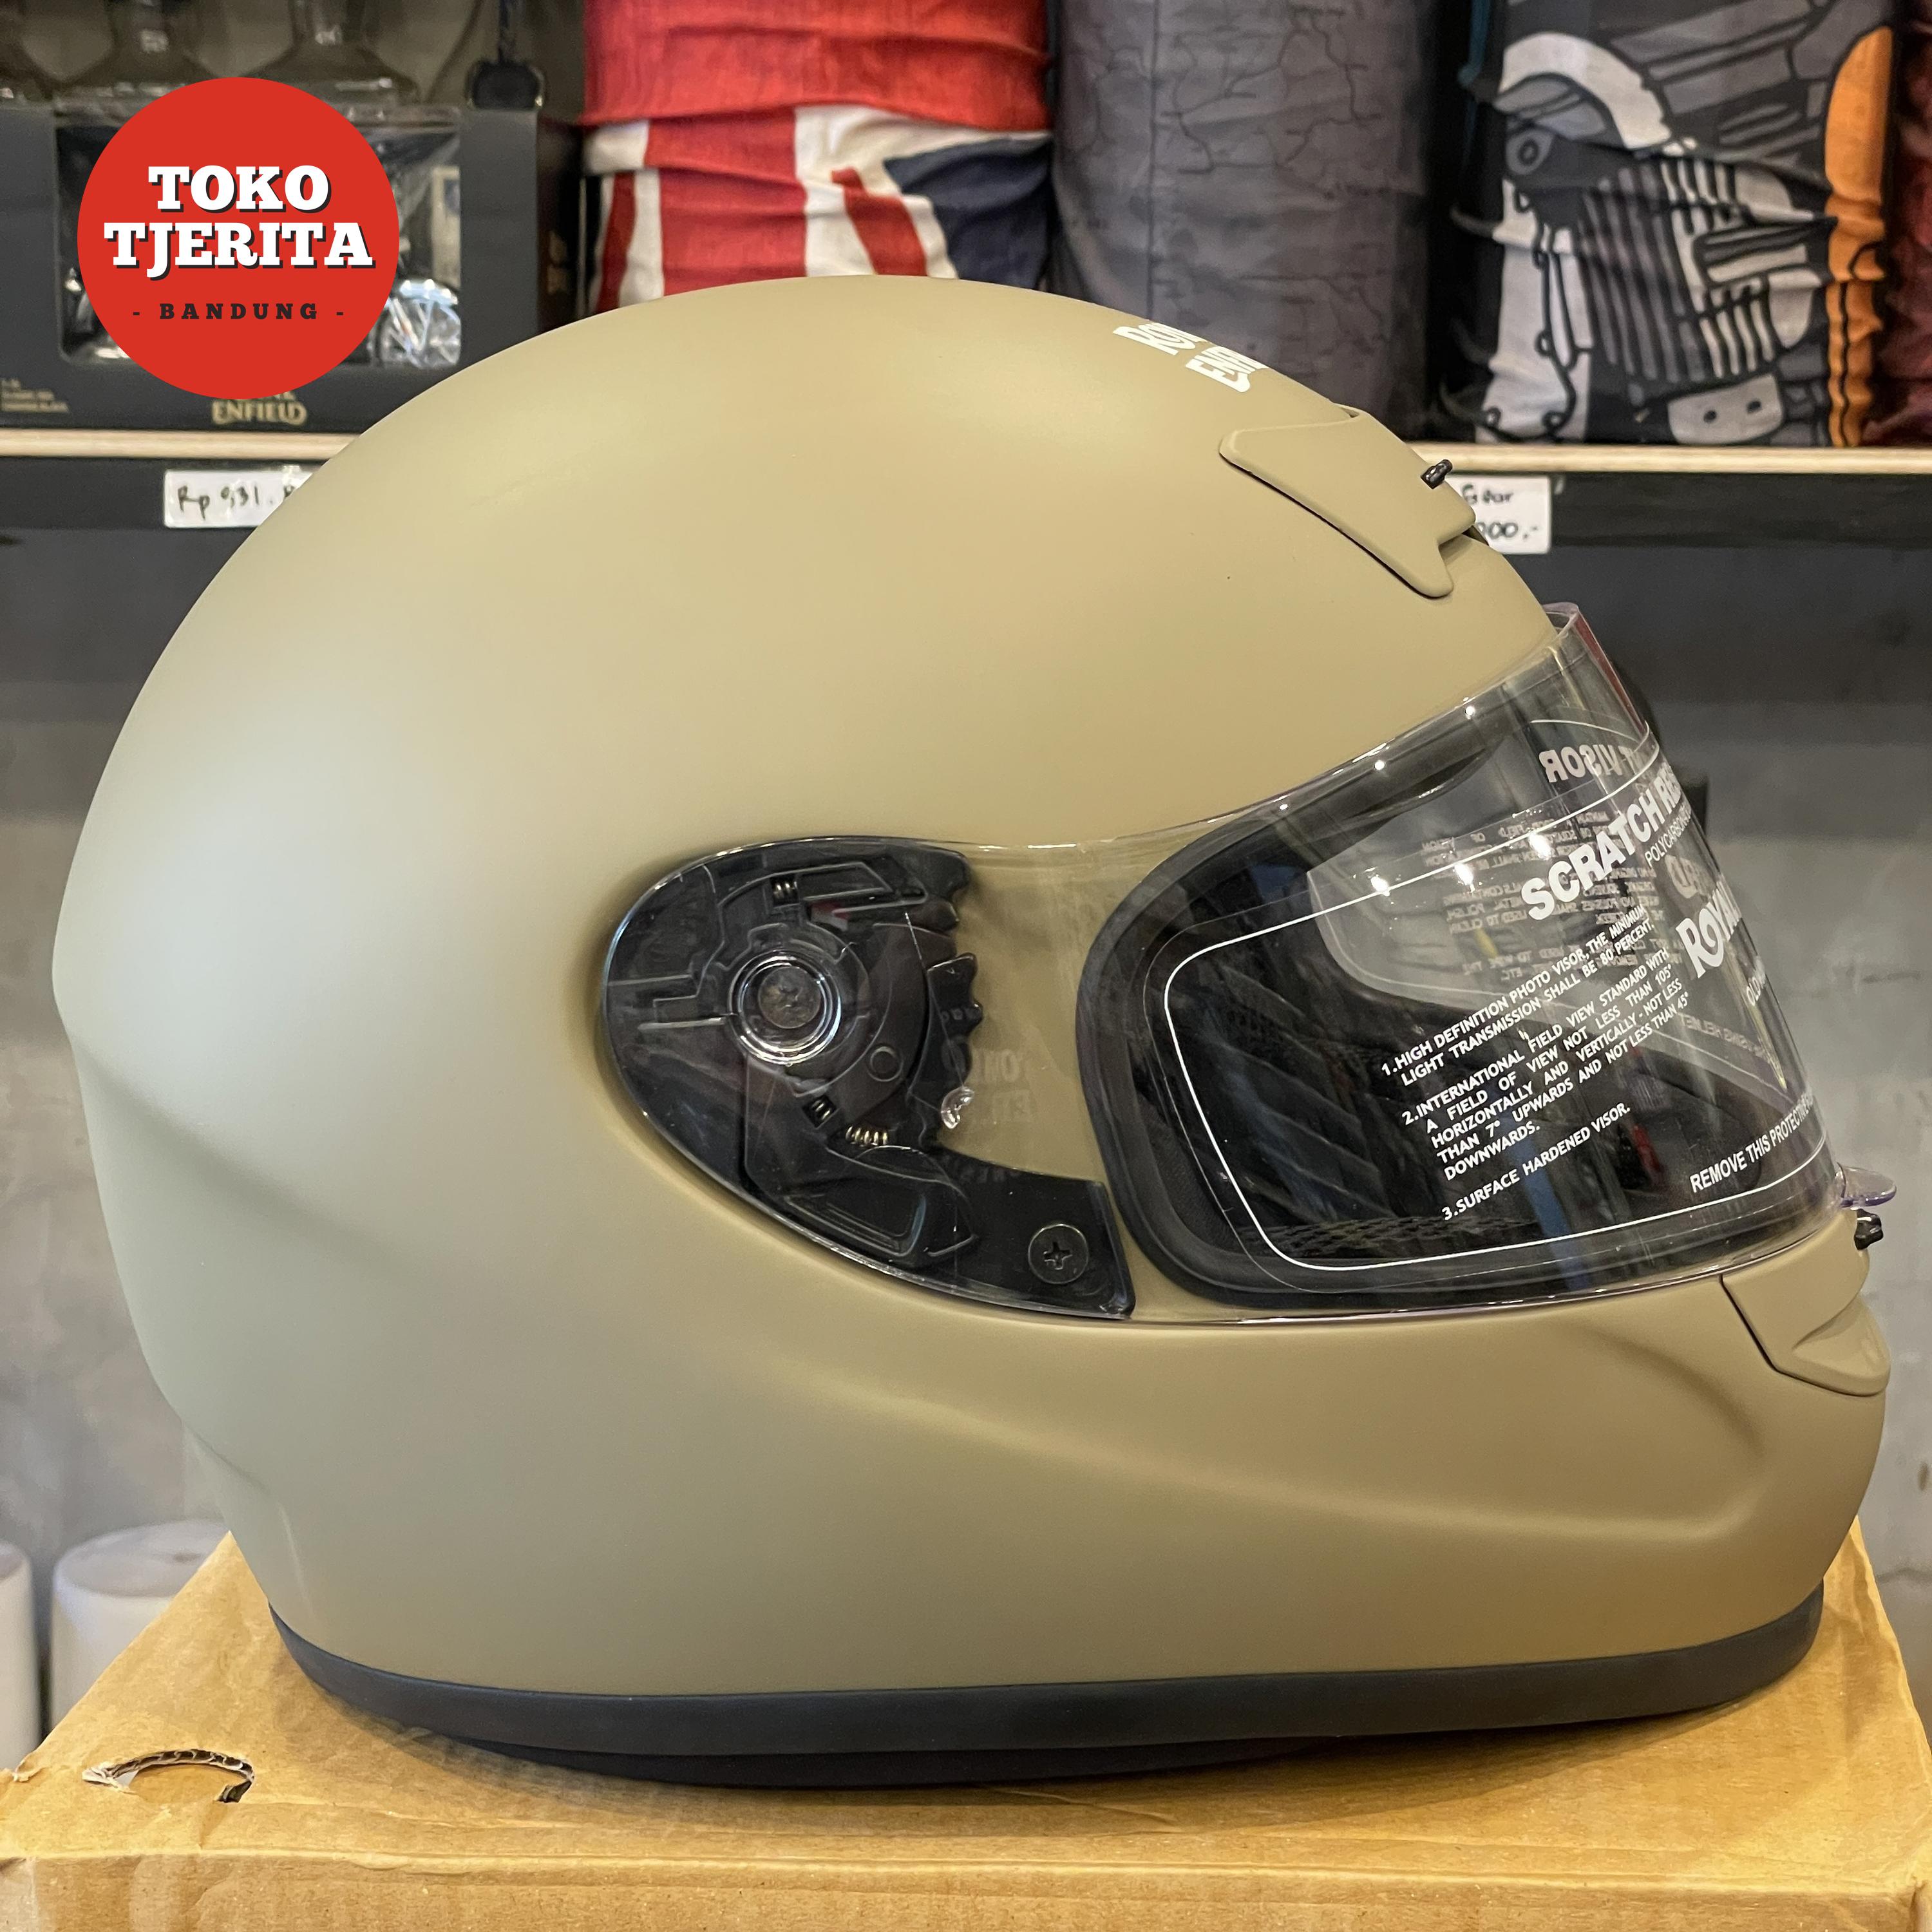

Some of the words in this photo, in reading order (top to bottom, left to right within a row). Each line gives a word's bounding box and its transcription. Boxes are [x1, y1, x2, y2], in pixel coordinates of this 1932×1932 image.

[211, 400, 307, 425] ENFIELD
[178, 485, 211, 520] Rp
[1521, 787, 1665, 920] SCRATCH
[1401, 1052, 1444, 1086] LIGHT
[1448, 996, 1542, 1058] TRANSMISSION
[1544, 973, 1581, 1002] SHALL
[1582, 960, 1598, 978] BE
[1600, 949, 1615, 965] 80
[1614, 918, 1655, 956] PERCENT.
[1401, 1050, 1525, 1125] 2.INTERNATIONAL
[1528, 1024, 1563, 1053] FIELD
[1566, 1001, 1595, 1028] VIEW
[1599, 965, 1647, 1007] STANDARD
[1646, 947, 1670, 972] WITH
[1434, 996, 1509, 1048] DEFINITION
[1509, 971, 1551, 1003] PHOTO
[1609, 904, 1647, 939] MINIMUM
[1426, 1119, 1438, 1133] A
[1446, 1090, 1488, 1121] FIELD
[1498, 1071, 1517, 1091] OF
[1526, 1045, 1558, 1073] VIEW
[1562, 1026, 1589, 1052] NOT
[1595, 1005, 1621, 1030] LESS
[1625, 981, 1653, 1007] THAN
[1431, 1081, 1533, 1149] HORIZONTALLY
[1543, 1060, 1569, 1086] AND
[1575, 1012, 1638, 1063] VERTICALLY
[1643, 992, 1663, 1016] NOT
[1662, 978, 1682, 1001] LESS
[1436, 1133, 1480, 1164] THAN
[1511, 1077, 1574, 1122] UPWARDS
[1578, 1059, 1602, 1084] AND
[1605, 1040, 1629, 1064] NOT
[1629, 1023, 1653, 1048] LESS
[1651, 1003, 1678, 1030] THAN
[1442, 1168, 1520, 1221] 3.SURFACE
[1522, 1126, 1591, 1176] HARDENED
[1591, 1102, 1631, 1133] VISOR.
[1444, 1121, 1540, 1180] DOWNWARDS.
[1689, 1150, 1748, 1193] REMOVE
[1745, 1130, 1771, 1163] THIS
